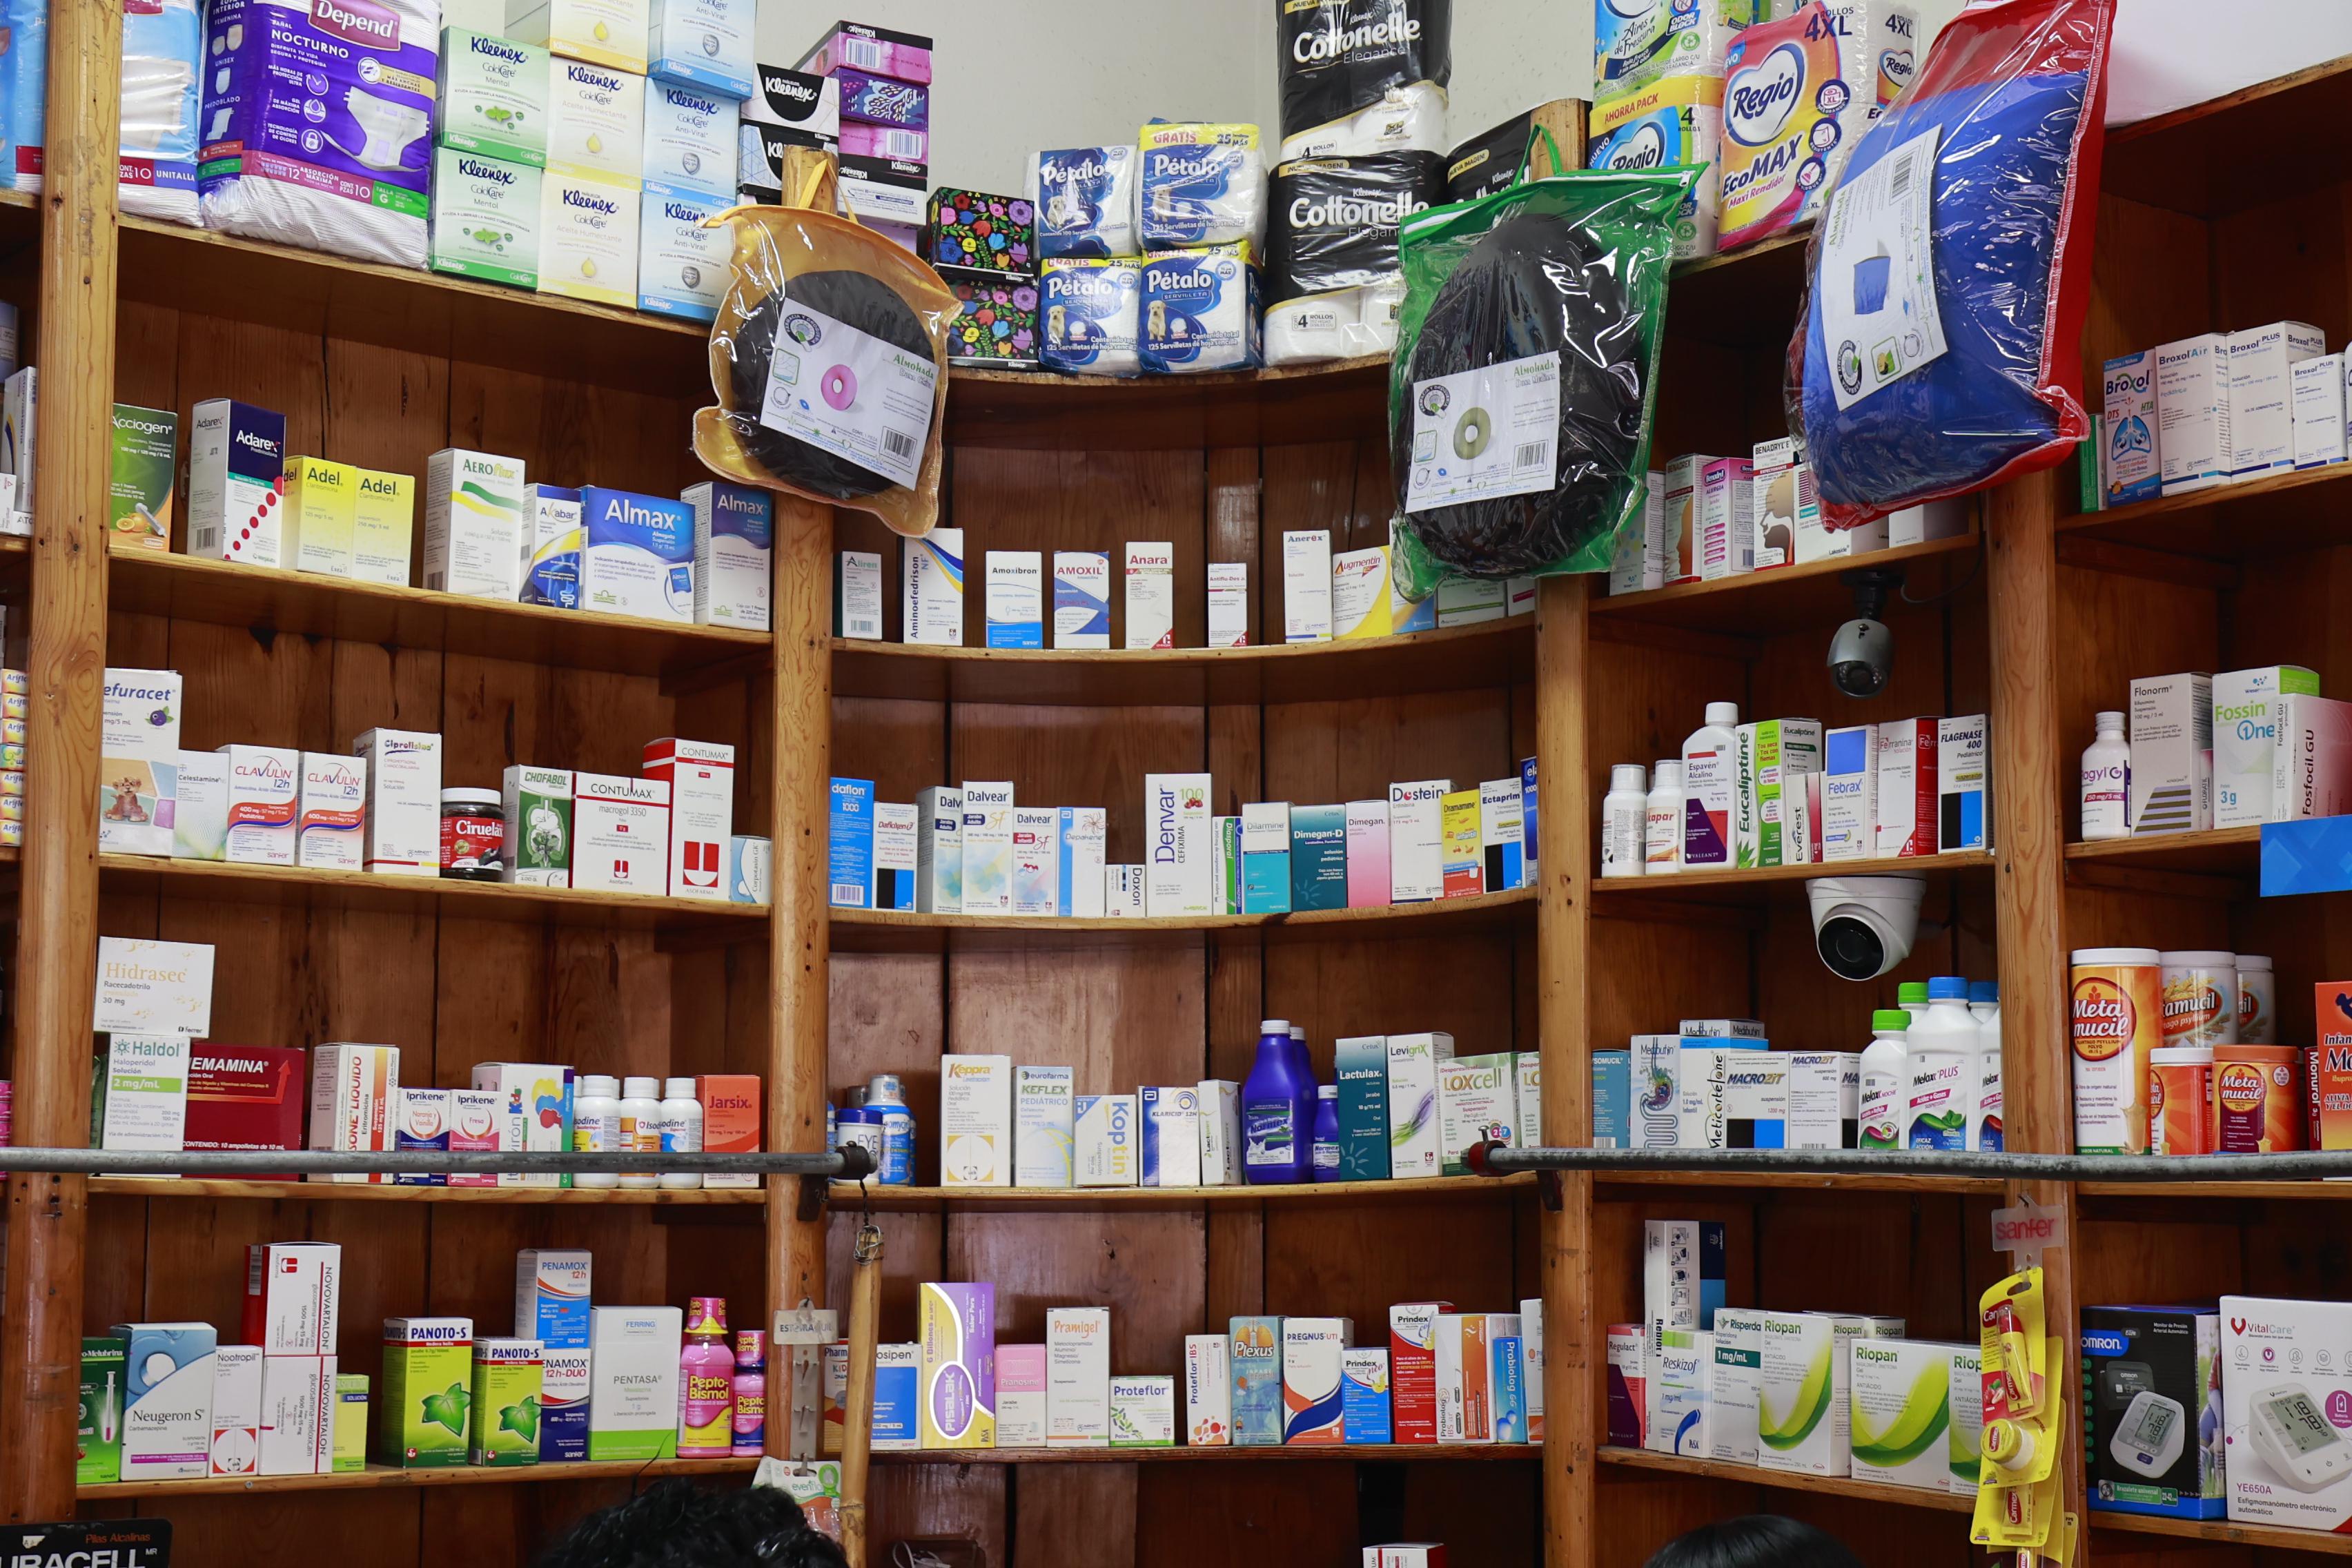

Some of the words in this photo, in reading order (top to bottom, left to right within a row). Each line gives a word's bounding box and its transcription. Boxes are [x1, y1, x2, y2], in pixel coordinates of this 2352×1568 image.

[317, 0, 393, 37] Depend
[1821, 7, 1854, 17] ROLLOS
[1625, 19, 1649, 39] Aires
[1805, 14, 1854, 41] 4XL
[1885, 14, 1912, 39] 4XL
[271, 29, 349, 58] NOCTURNO
[1293, 17, 1421, 63] Cottonelle
[1614, 45, 1625, 55] de
[1623, 25, 1656, 48] Frescura
[471, 37, 525, 65] Kleenex
[485, 75, 510, 88] Mentol
[567, 66, 621, 92] Kleenex
[765, 77, 814, 101] Kleenex
[1733, 73, 1793, 119] Regio
[666, 89, 717, 115] Kleenex
[1603, 97, 1634, 125] AHORRA
[1635, 93, 1658, 111] PACK
[1154, 132, 1197, 144] GRATIS
[1313, 141, 1335, 151] ROLLOS
[1153, 153, 1220, 176] Pétalo
[1723, 134, 1801, 197] EcoMAX
[155, 168, 195, 182] UNITALLA
[459, 159, 515, 186] Kleenex
[1728, 192, 1750, 208] Maxi
[1750, 174, 1786, 199] Rendidor
[379, 193, 389, 204] G
[473, 198, 499, 209] Mentol
[562, 189, 617, 215] Kleenex
[1289, 191, 1429, 229] Cottonelle
[1047, 257, 1090, 266] GRATIS
[1108, 259, 1123, 267] 25
[1048, 277, 1113, 299] Pétalo
[1147, 270, 1212, 293] Pétalo
[1298, 314, 1308, 328] 4
[2106, 371, 2150, 395] Broxol
[236, 430, 279, 452] Adarex
[307, 467, 340, 487] Adel
[360, 478, 396, 496] Adel
[1705, 485, 1724, 494] ALERGIA
[717, 495, 763, 515] Almax
[605, 499, 676, 531] Almax
[491, 527, 512, 537] Solución
[1288, 534, 1323, 542] Anerex
[921, 557, 928, 570] NF
[1130, 555, 1168, 565] Anara
[1335, 556, 1381, 574] Augmentin
[1057, 567, 1103, 575] AMOXIL
[910, 556, 919, 639] Aminoefedrison
[2134, 686, 2169, 697] Flonorm
[2215, 701, 2265, 722] Fossin
[1784, 727, 1815, 736] Eucaliptine
[1941, 730, 1983, 743] FLAGENASE
[1966, 740, 1982, 749] 400
[681, 747, 725, 759] CONTUMAX
[1957, 751, 1983, 759] Pediátrico
[1689, 762, 1717, 771] Espavén
[178, 774, 219, 783] Celestamine
[525, 772, 567, 785] CHOFABOL
[1738, 732, 1749, 833] Eucaliptine
[343, 787, 358, 795] 12h
[591, 783, 653, 799] CONTUMAX
[832, 784, 865, 795] daflon
[1829, 778, 1862, 794] Febrax
[967, 790, 1008, 803] Dalvear
[1482, 794, 1520, 805] Ectaprim
[2221, 791, 2228, 803] 3
[2230, 792, 2236, 805] g
[599, 805, 629, 816] macrogol
[630, 807, 646, 817] 3350
[843, 802, 859, 812] 1000
[1017, 814, 1051, 823] Dalvear
[1155, 788, 1175, 863] Denvar
[456, 820, 503, 837] Ciruelax
[1294, 830, 1343, 839] Dimegan-D
[1794, 807, 1803, 861] Everest
[1065, 832, 1102, 841] Depakene
[1133, 868, 1142, 905] Daxon
[106, 963, 186, 983] Hidrasec
[104, 981, 150, 990] Racecadotrilo
[2073, 1000, 2124, 1019] Meta
[2074, 1018, 2128, 1037] mucil
[133, 1041, 180, 1057] Haldol
[114, 1058, 155, 1066] Haloperidol
[1792, 1055, 1836, 1065] MACROZIT
[949, 1063, 991, 1078] Keppra
[1340, 1069, 1380, 1080] Lactulax
[2309, 1051, 2319, 1104] Monurol
[114, 1078, 120, 1087] 2
[121, 1079, 160, 1090] mg/mL
[353, 1056, 362, 1108] LIQUIDO
[2222, 1075, 2259, 1088] Meta
[406, 1092, 444, 1101] Iprikene
[1021, 1084, 1067, 1095] KEFLEX
[2222, 1088, 2262, 1100] mucil
[458, 1096, 496, 1105] Iprikene
[709, 1095, 749, 1109] Jarsix
[1020, 1097, 1068, 1105] PEDIÁTRICO
[1107, 1101, 1126, 1175] Koptin
[1995, 1218, 2054, 1242] sanfer
[542, 1262, 586, 1270] PENAMOX
[322, 1266, 332, 1349] NOVOVARTALON
[411, 1327, 466, 1339] PANOTO-S
[1054, 1320, 1099, 1338] Pramigel
[1765, 1320, 1801, 1335] Riopan
[1834, 1325, 1862, 1334] Riopan
[1876, 1326, 1903, 1336] Riopan
[2247, 1322, 2291, 1335] VitalCare
[492, 1348, 539, 1358] PANOTO-S
[1233, 1342, 1274, 1358] Plexus
[1609, 1341, 1635, 1351] Regulact
[217, 1353, 256, 1362] Nootropil
[1723, 1351, 1747, 1363] mg/mL
[1856, 1347, 1898, 1362] Riopan
[614, 1375, 658, 1384] PENTASA
[689, 1386, 729, 1400] Bismol
[1113, 1385, 1166, 1396] Proteflor
[133, 1409, 191, 1424] Neugeron
[194, 1409, 202, 1420] S
[319, 1374, 330, 1455] NOVOVARTALON
[2237, 1483, 2272, 1494] YE650A
[2237, 1498, 2298, 1509] Esfigmomanómetro
[2300, 1502, 2337, 1513] electrónico
[2238, 1507, 2273, 1516] automático
[86, 1534, 106, 1543] Pilas
[110, 1533, 150, 1542] Alcalinas
